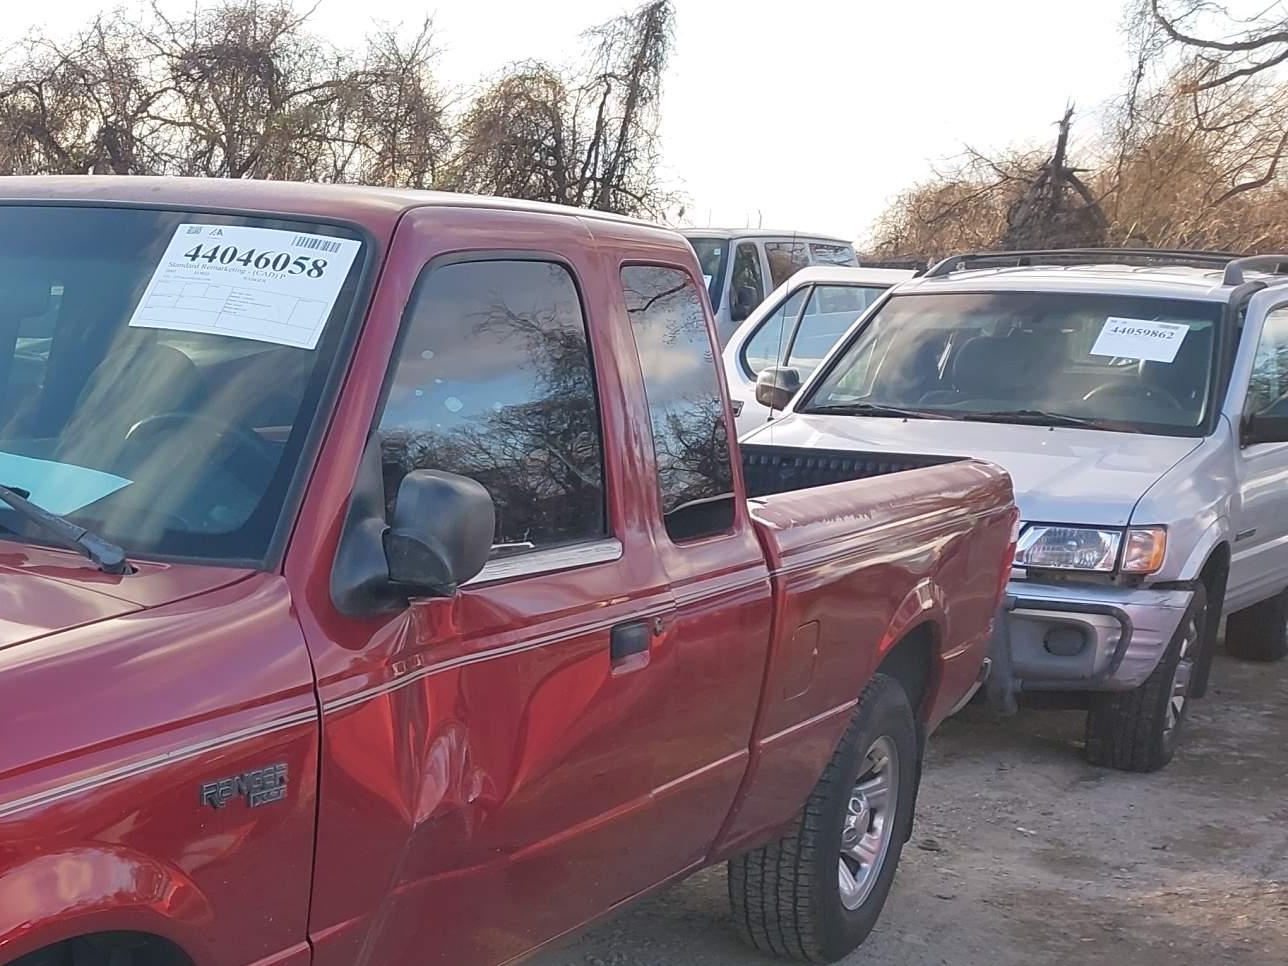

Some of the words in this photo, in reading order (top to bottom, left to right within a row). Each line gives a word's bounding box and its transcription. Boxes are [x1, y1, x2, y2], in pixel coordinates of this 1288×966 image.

[184, 243, 328, 279] 44046058
[1111, 326, 1175, 340] 44059862
[201, 763, 289, 809] RANGER
